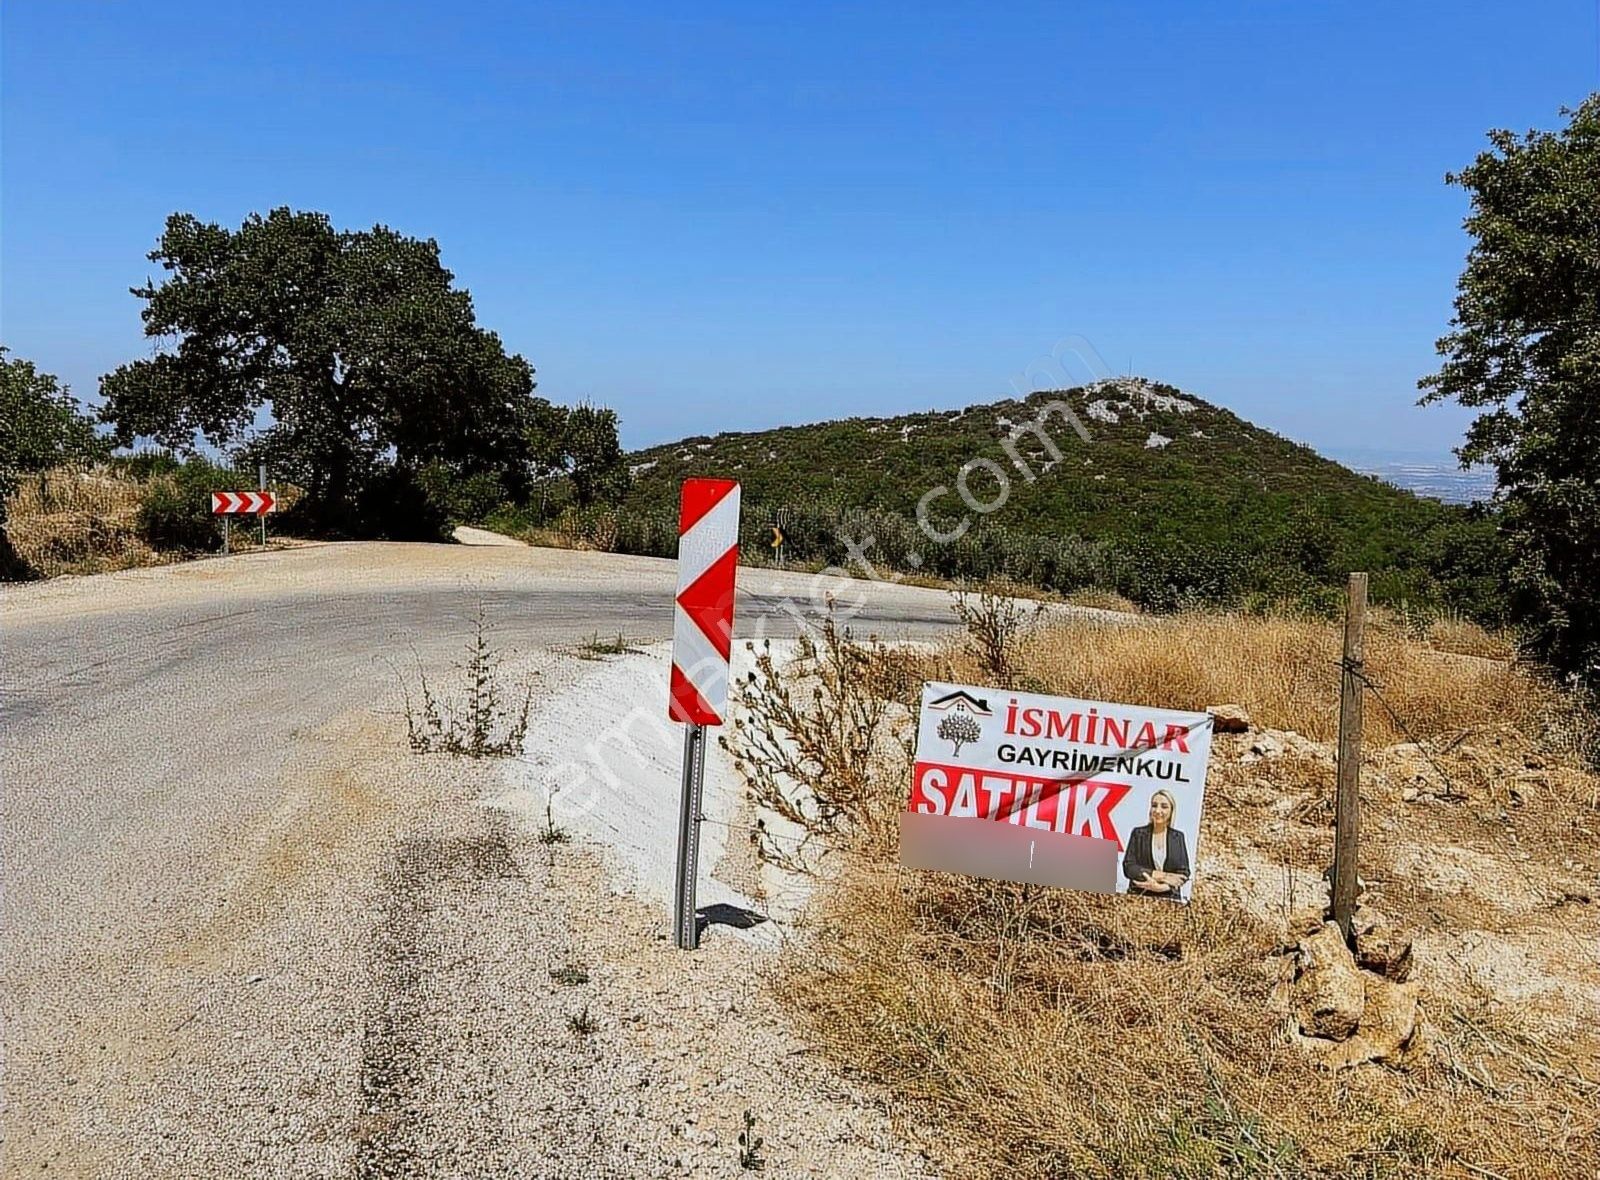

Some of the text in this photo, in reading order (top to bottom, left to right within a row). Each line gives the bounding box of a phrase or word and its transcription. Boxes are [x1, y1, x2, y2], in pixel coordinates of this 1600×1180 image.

[1004, 698, 1190, 753] İSMİNAR
[997, 743, 1190, 783] GAYRİMENKUL
[917, 769, 1111, 839] SATILIK
